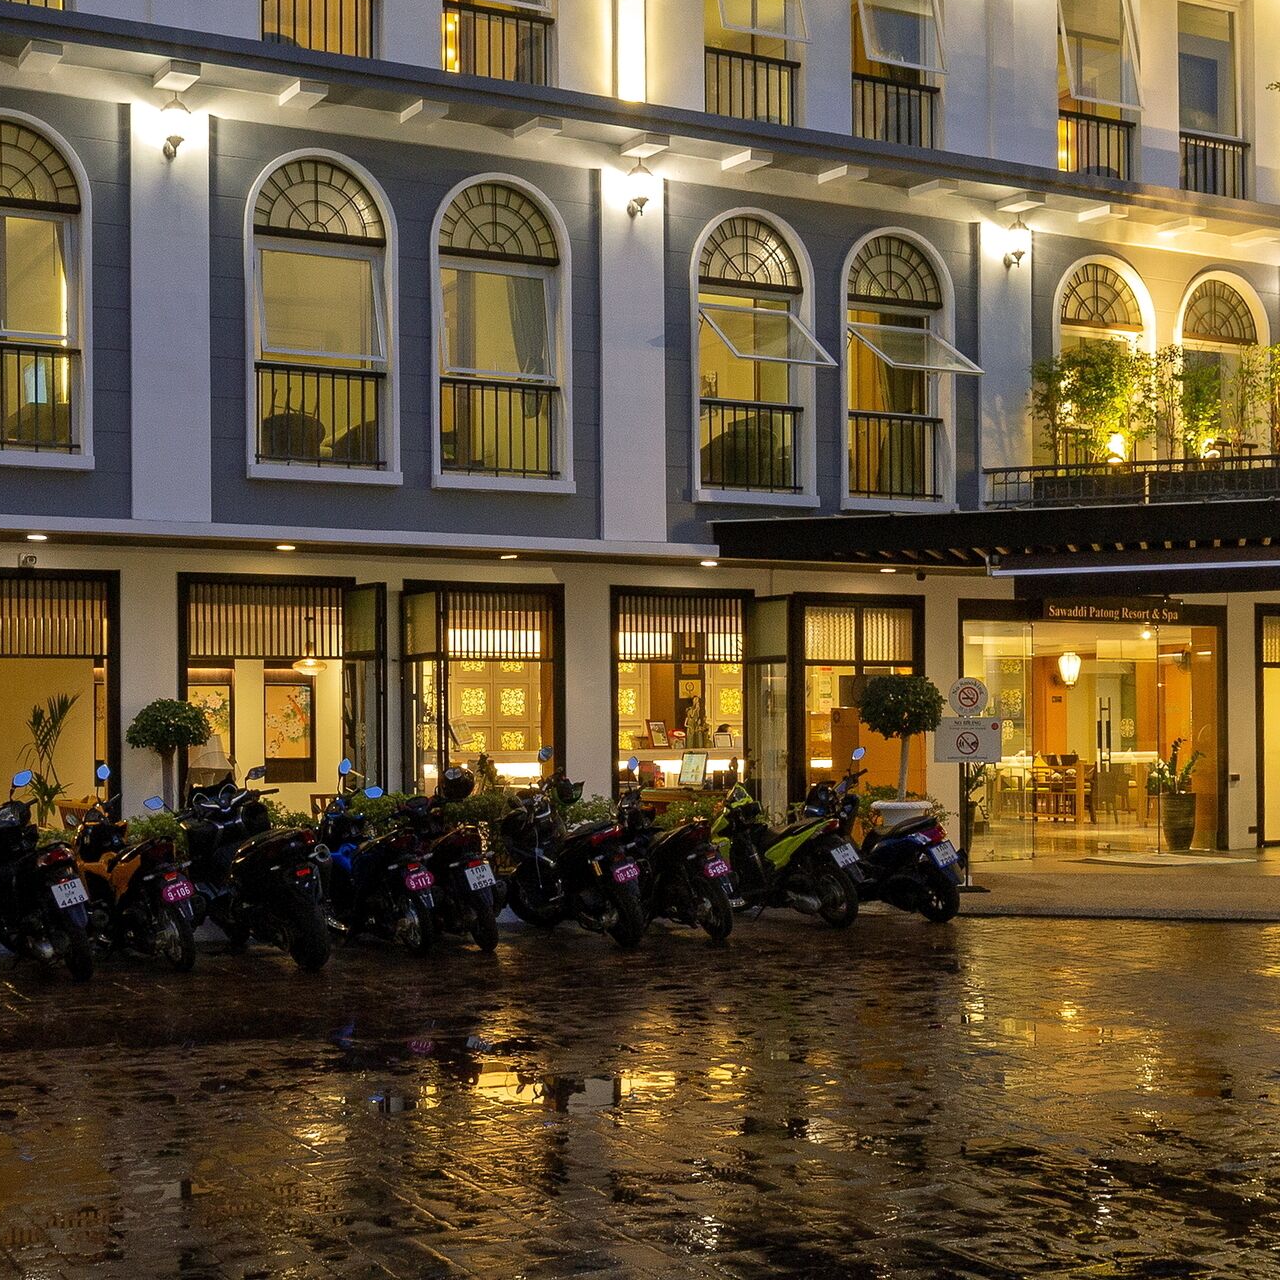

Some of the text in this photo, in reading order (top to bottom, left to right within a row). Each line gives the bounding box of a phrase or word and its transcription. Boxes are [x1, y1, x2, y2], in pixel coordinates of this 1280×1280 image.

[1048, 605, 1178, 622] Sawaddi Patong Resort & Spa
[61, 894, 85, 907] 4418
